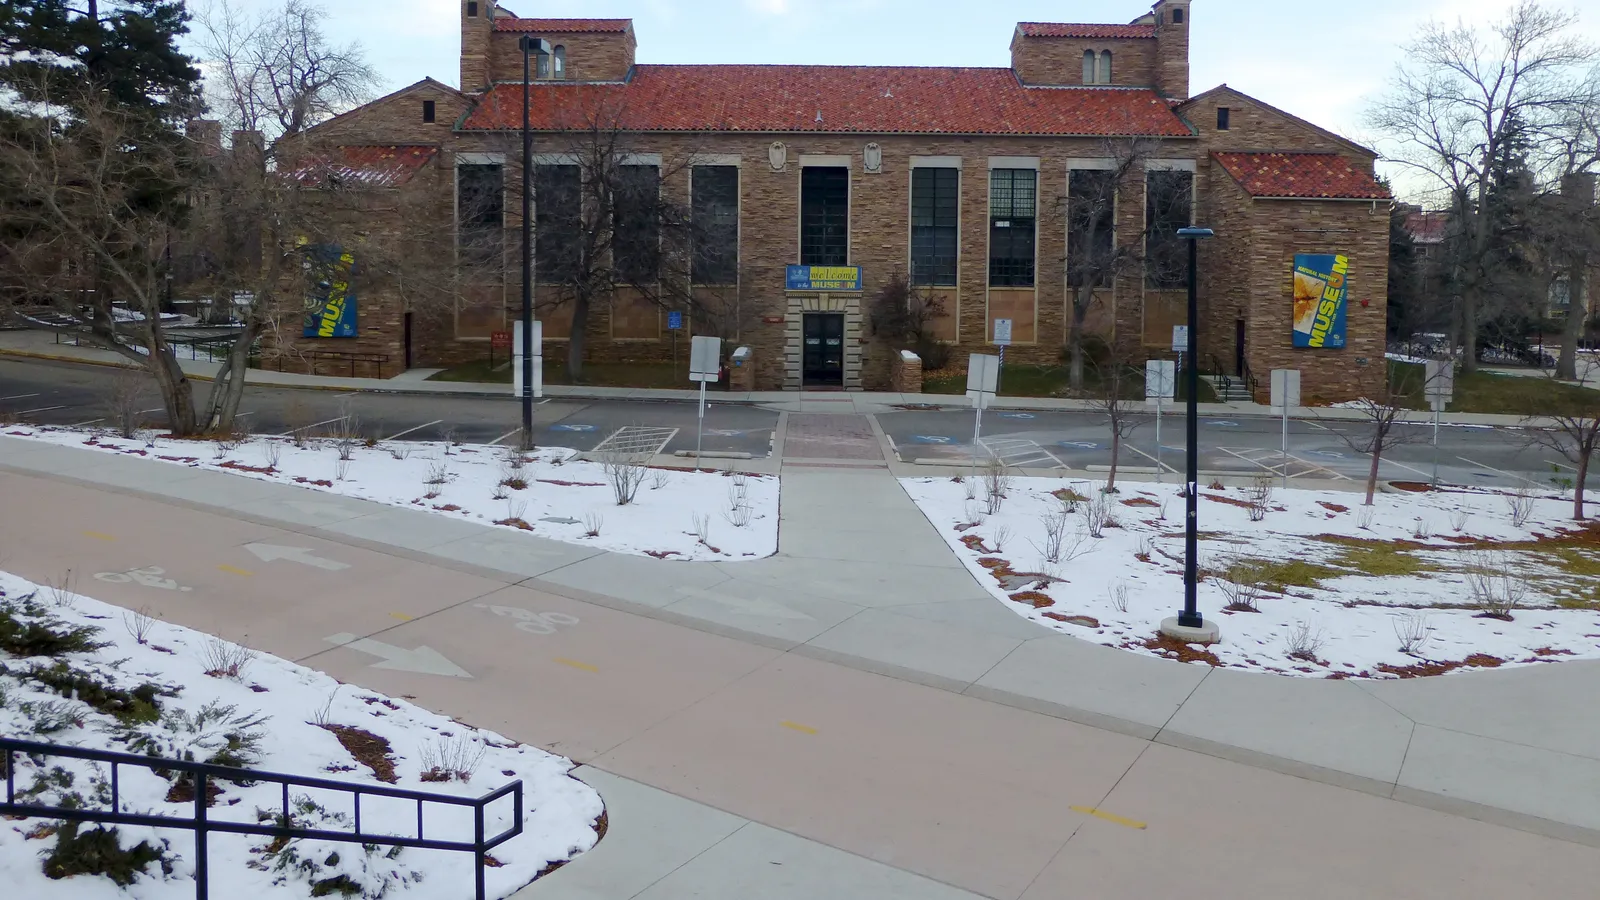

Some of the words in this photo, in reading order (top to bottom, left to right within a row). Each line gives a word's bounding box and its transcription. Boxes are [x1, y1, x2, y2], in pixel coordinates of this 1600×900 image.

[811, 268, 857, 279] welcome
[811, 281, 856, 289] MUSEUM
[1308, 254, 1348, 347] MUSEUM
